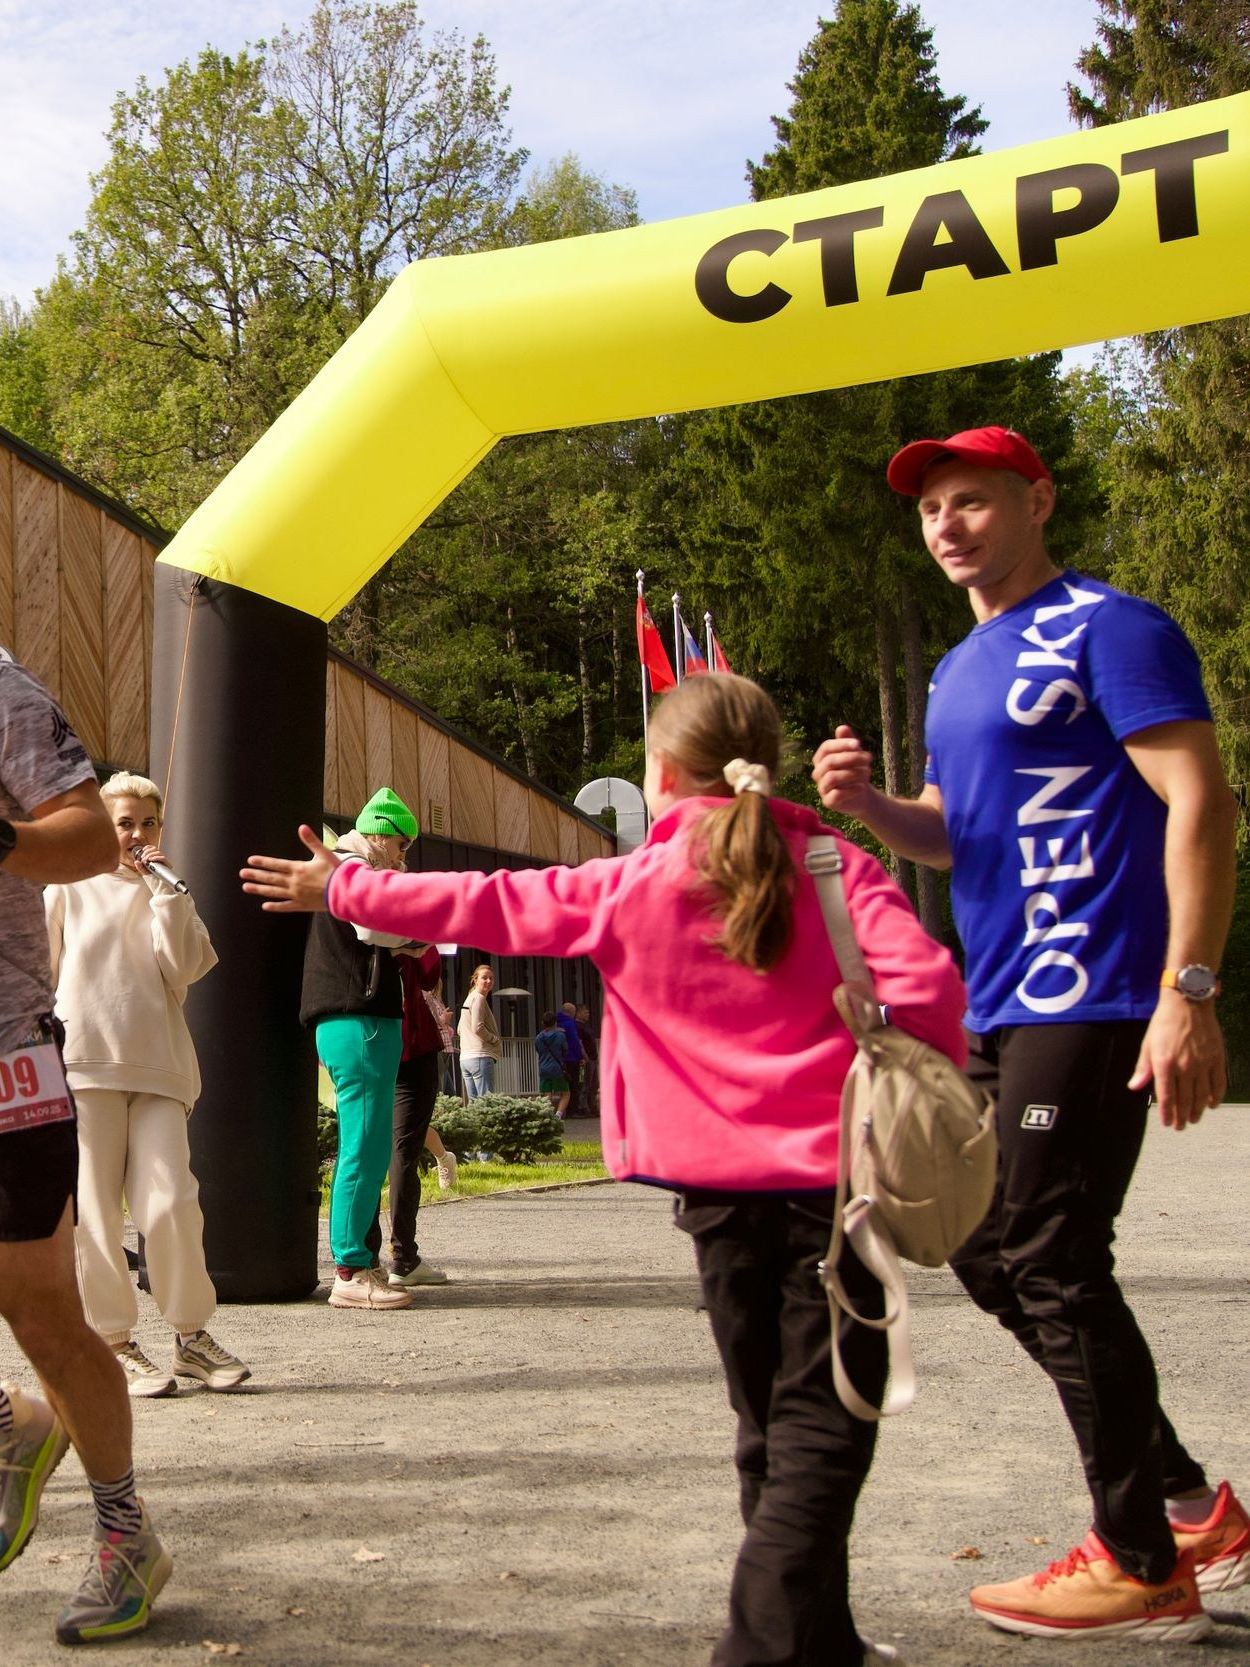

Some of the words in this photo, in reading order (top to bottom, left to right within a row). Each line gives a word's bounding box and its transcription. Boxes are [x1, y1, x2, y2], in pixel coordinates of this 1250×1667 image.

[695, 129, 1229, 323] СТАРТ
[1006, 581, 1105, 727] SKY
[1014, 765, 1094, 1014] OPEN
